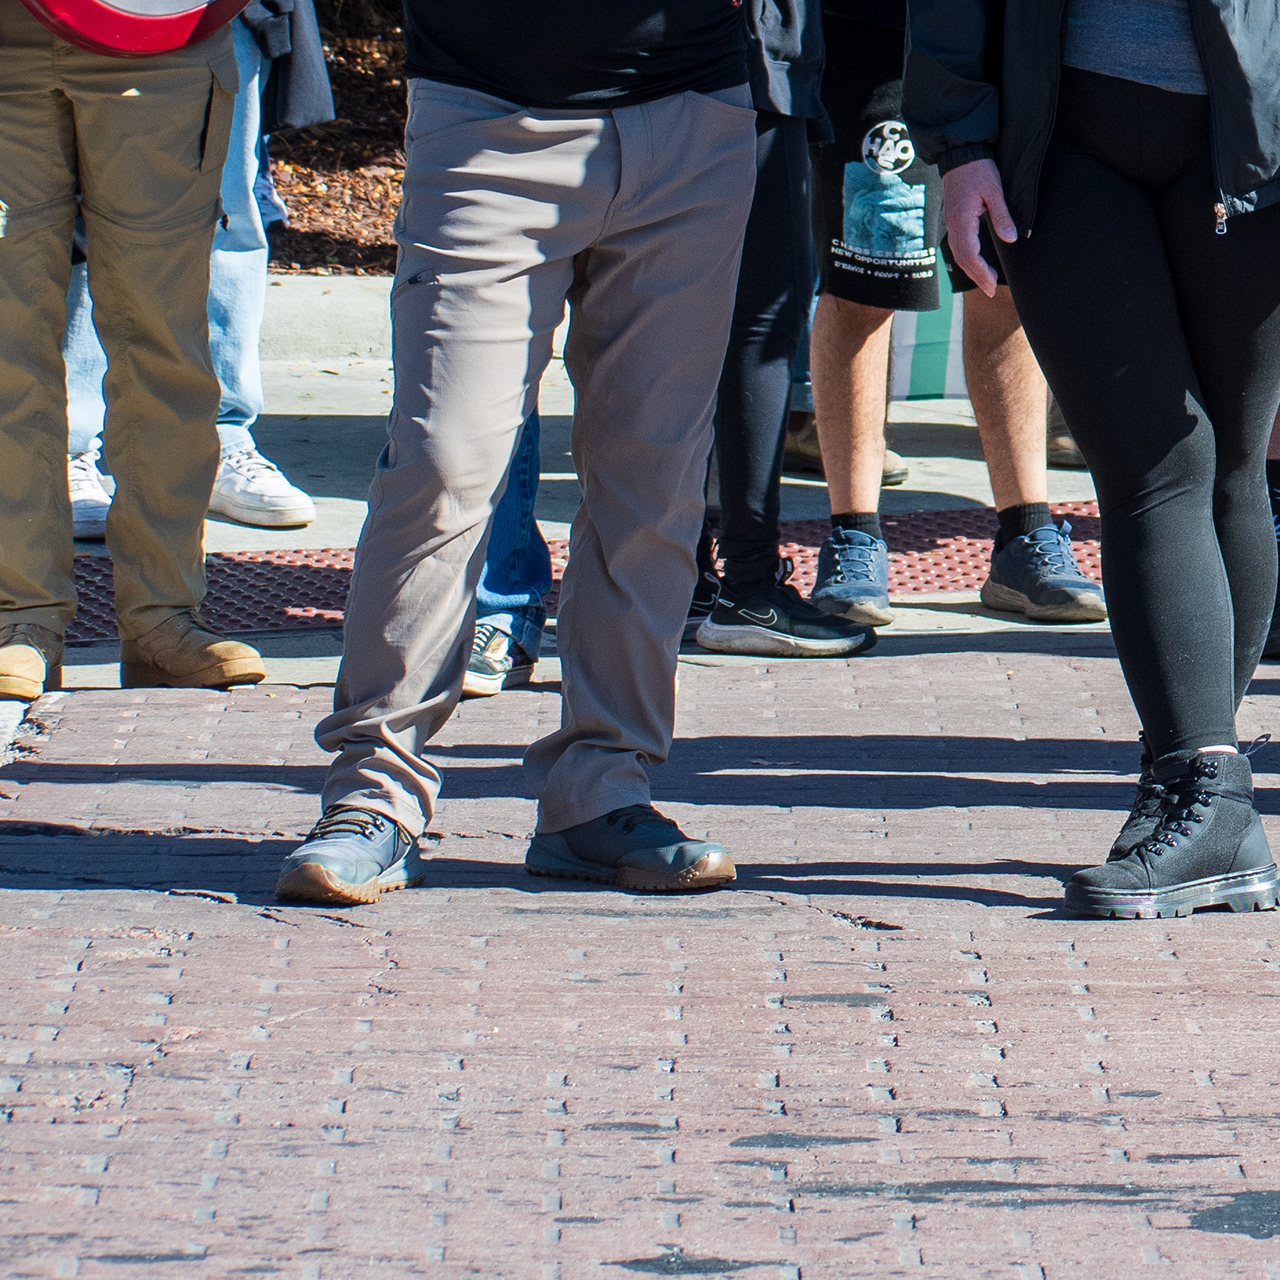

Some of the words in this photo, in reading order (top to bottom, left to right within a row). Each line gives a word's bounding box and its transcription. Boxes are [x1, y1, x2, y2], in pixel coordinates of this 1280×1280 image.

[830, 246, 853, 259] NEW
[854, 253, 936, 267] OPPORTUNITIES
[831, 239, 871, 256] CHAOS
